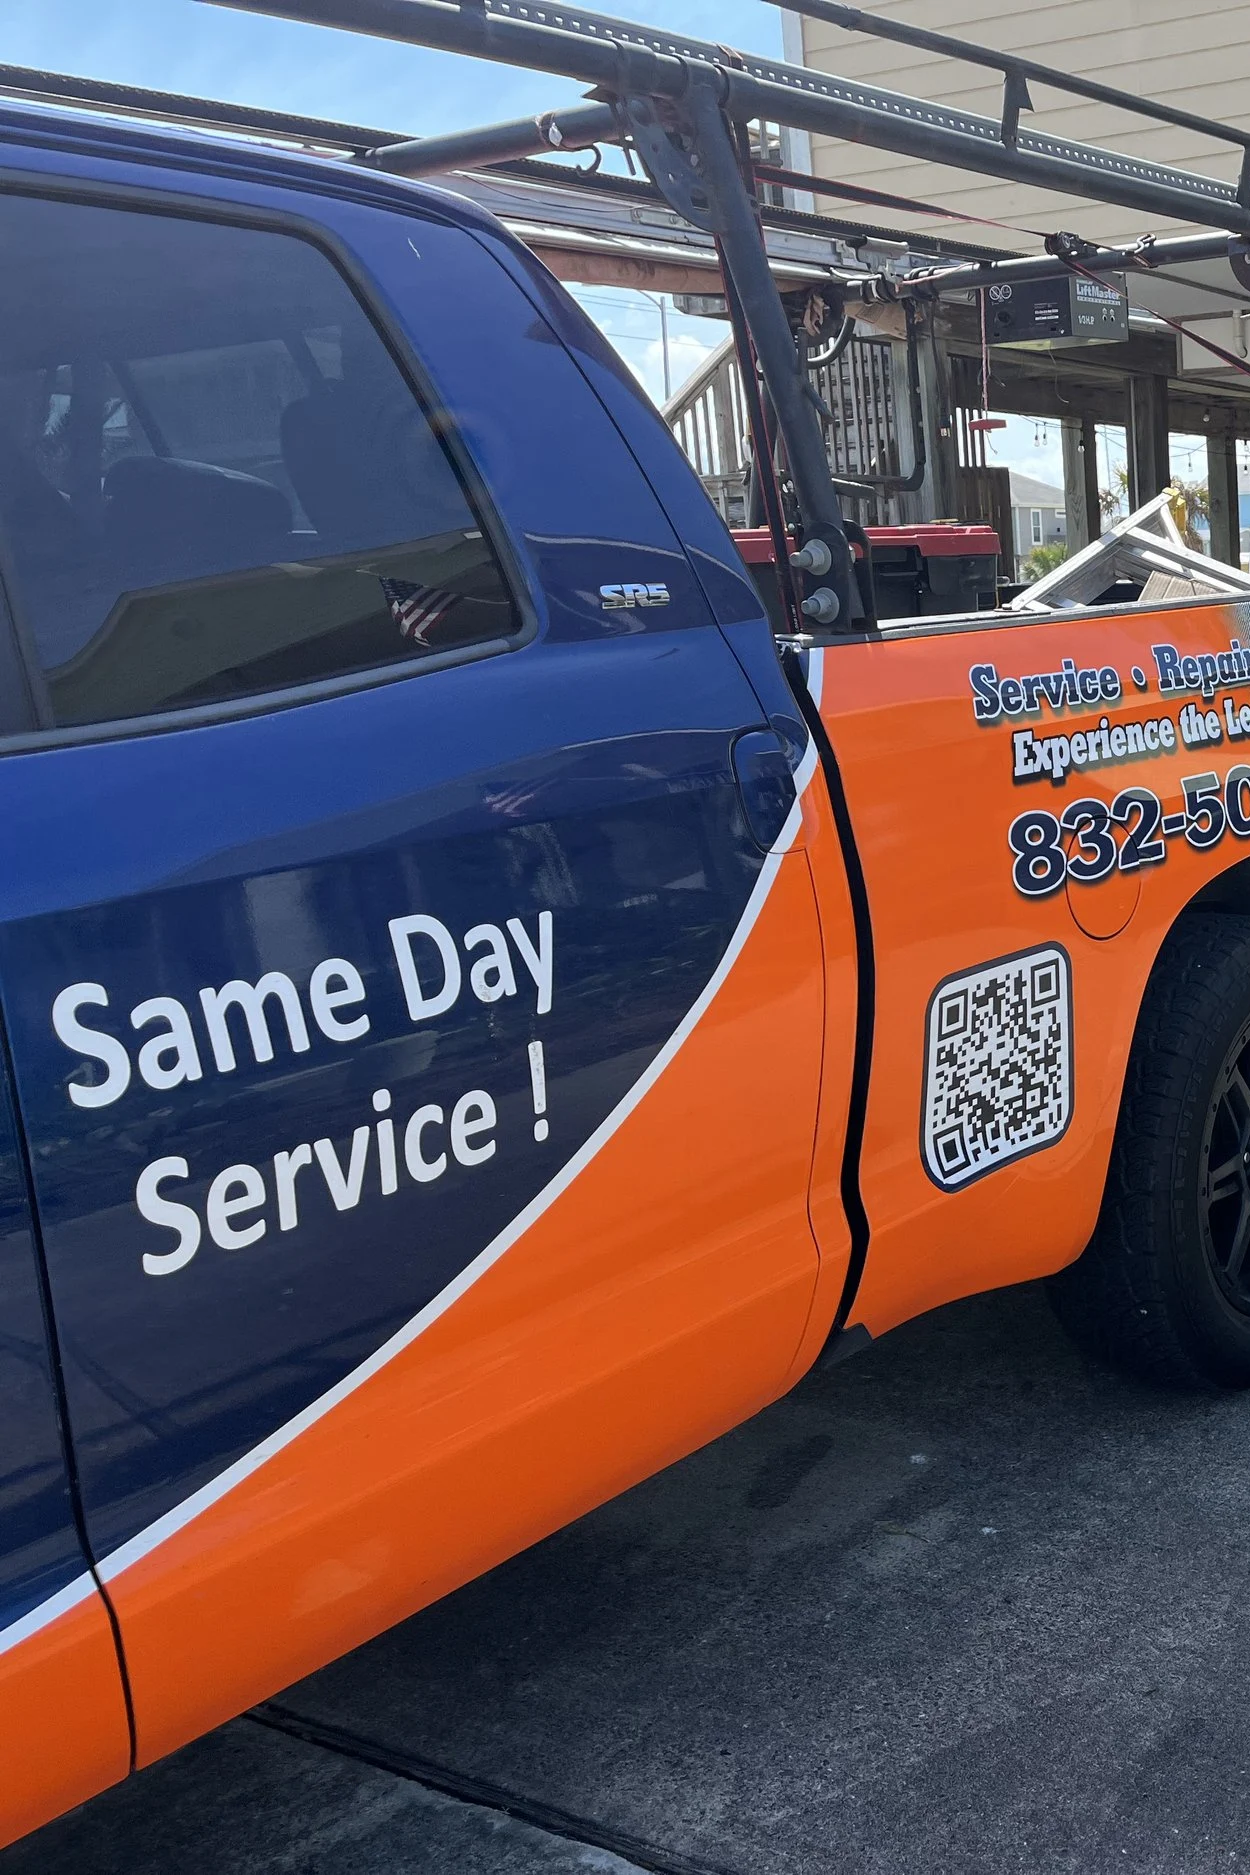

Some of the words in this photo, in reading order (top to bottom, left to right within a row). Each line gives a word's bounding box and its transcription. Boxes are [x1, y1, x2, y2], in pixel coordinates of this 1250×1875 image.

[1076, 283, 1120, 300] LiftMaster
[600, 583, 670, 609] SR5
[969, 659, 1120, 720] Service
[1012, 715, 1176, 780] Experience
[1179, 702, 1222, 745] the
[52, 957, 371, 1108] Same
[388, 910, 552, 1022] Day
[136, 1088, 497, 1276] Service
